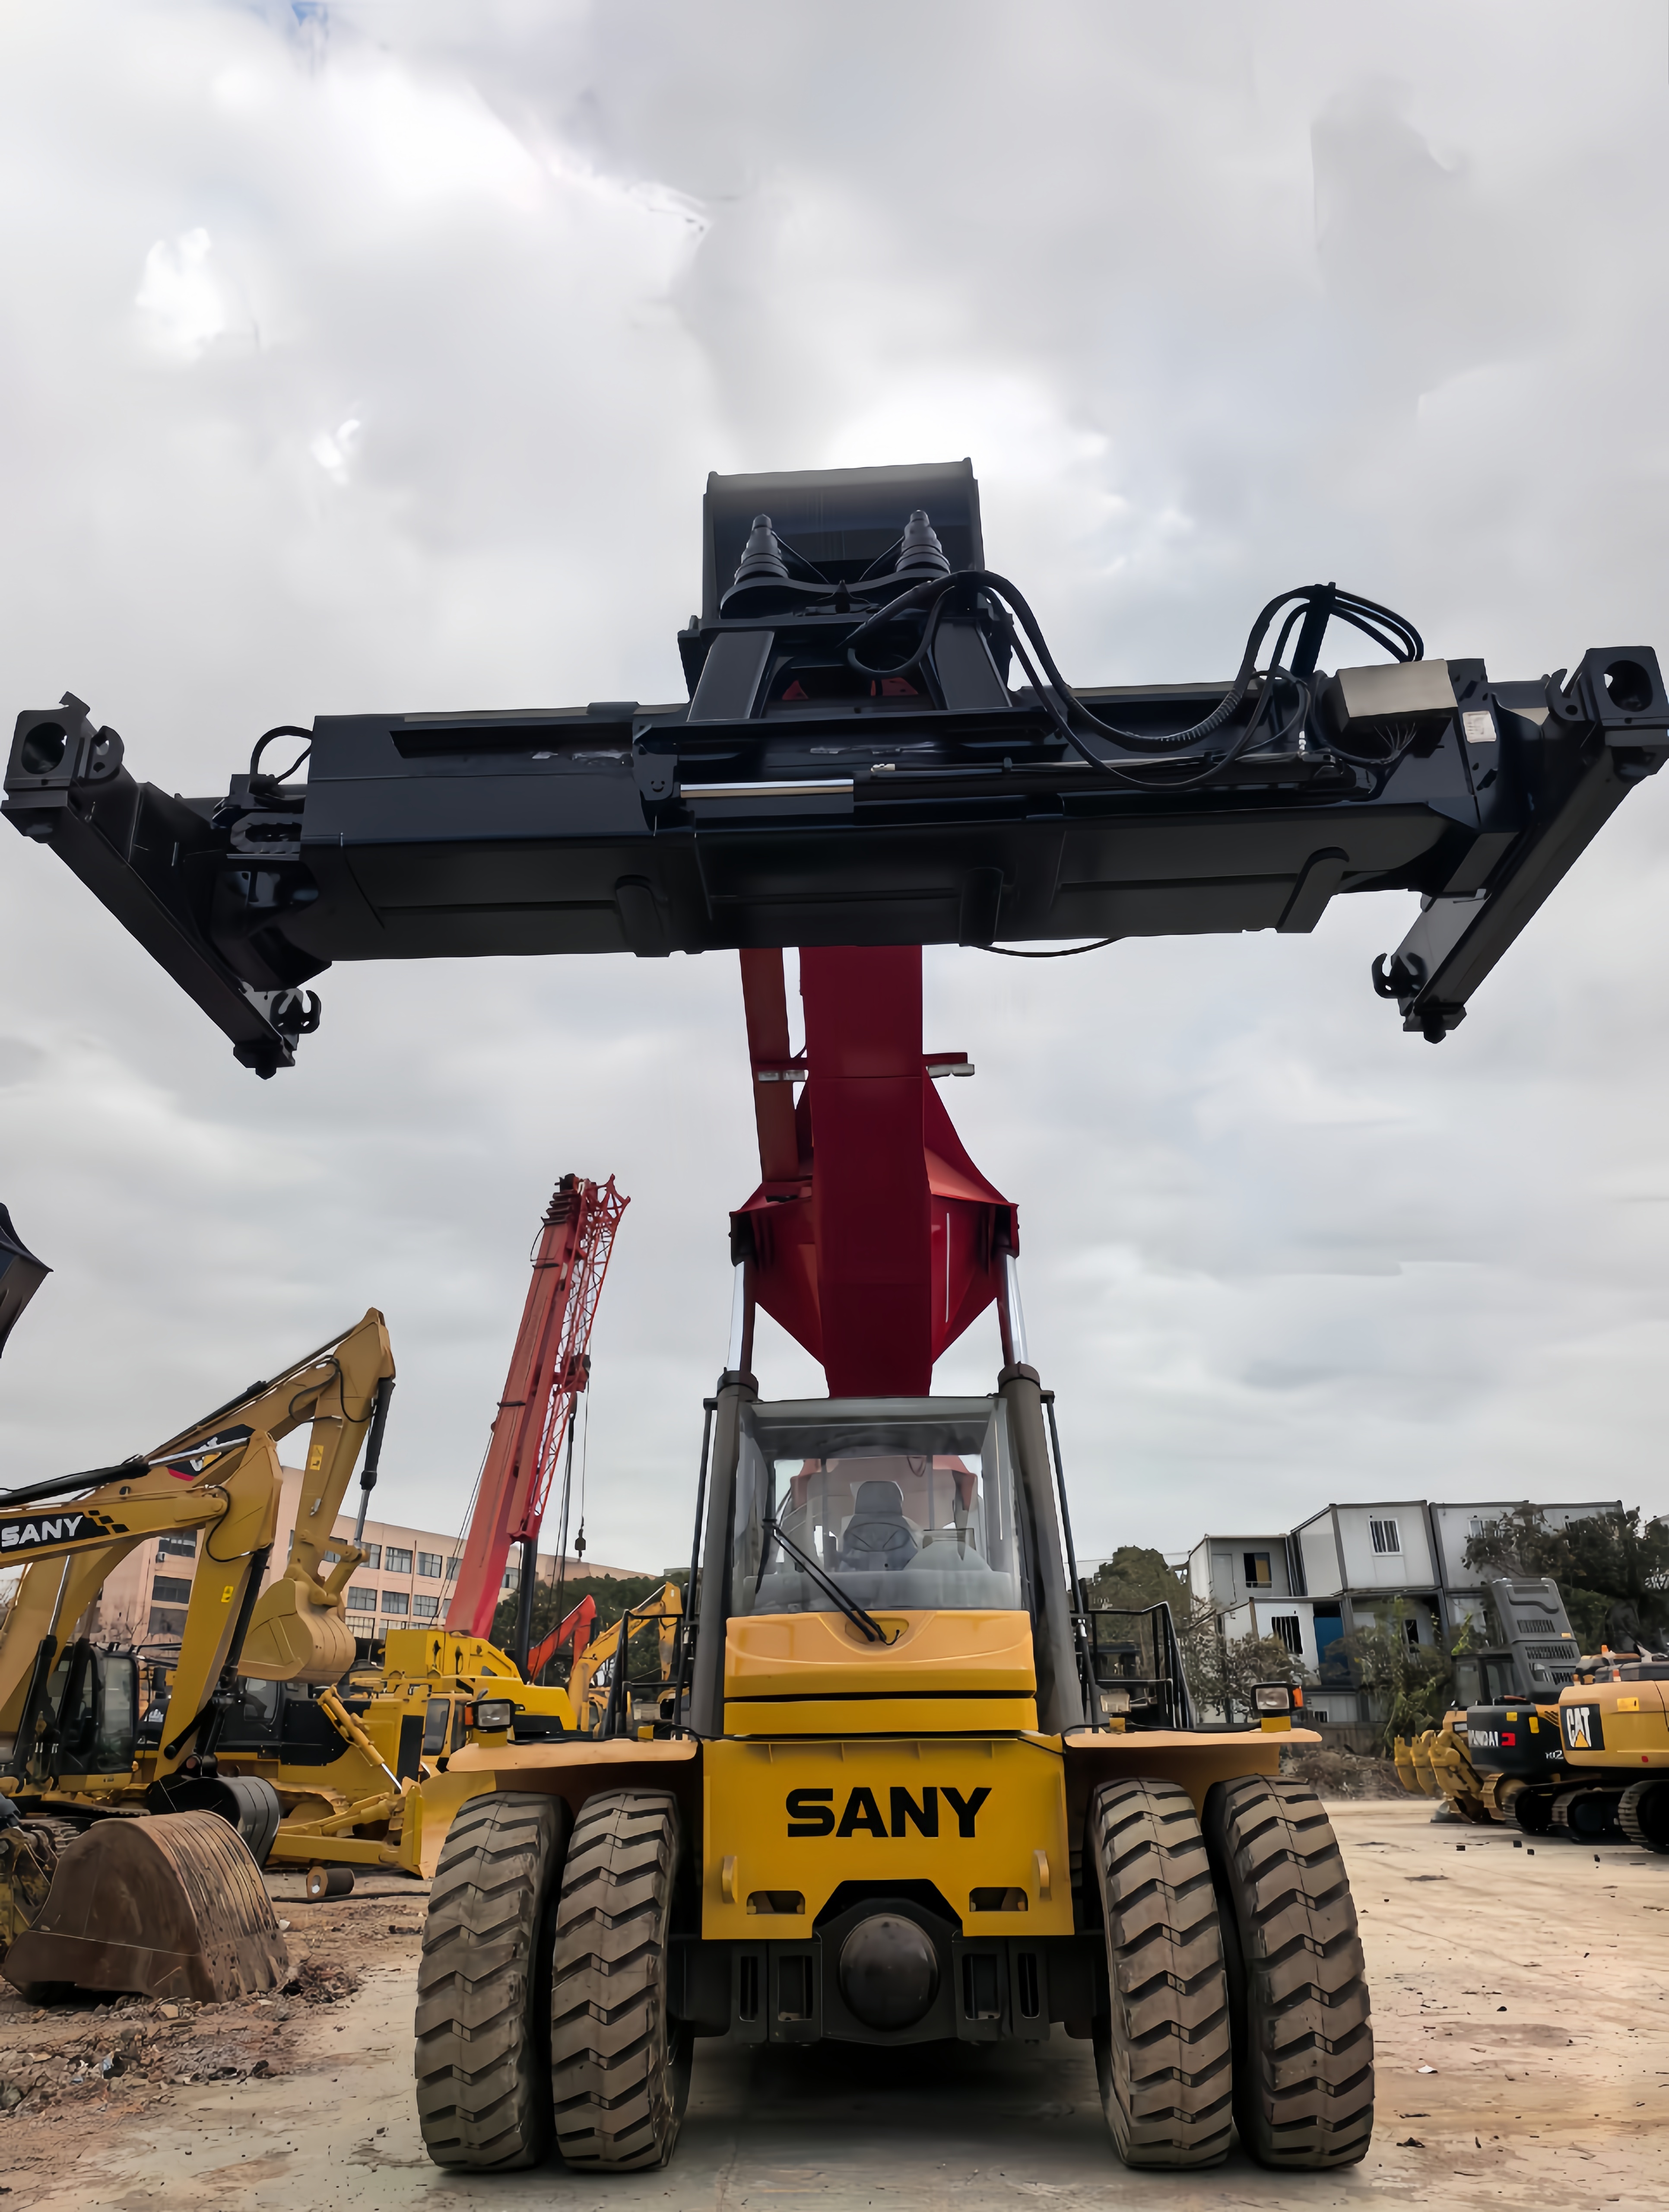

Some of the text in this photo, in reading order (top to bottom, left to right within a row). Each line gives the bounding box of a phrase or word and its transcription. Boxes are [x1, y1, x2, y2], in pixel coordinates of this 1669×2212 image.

[1, 1515, 83, 1547] SANY
[1566, 1707, 1592, 1748] CAT
[786, 1786, 992, 1838] SANY
